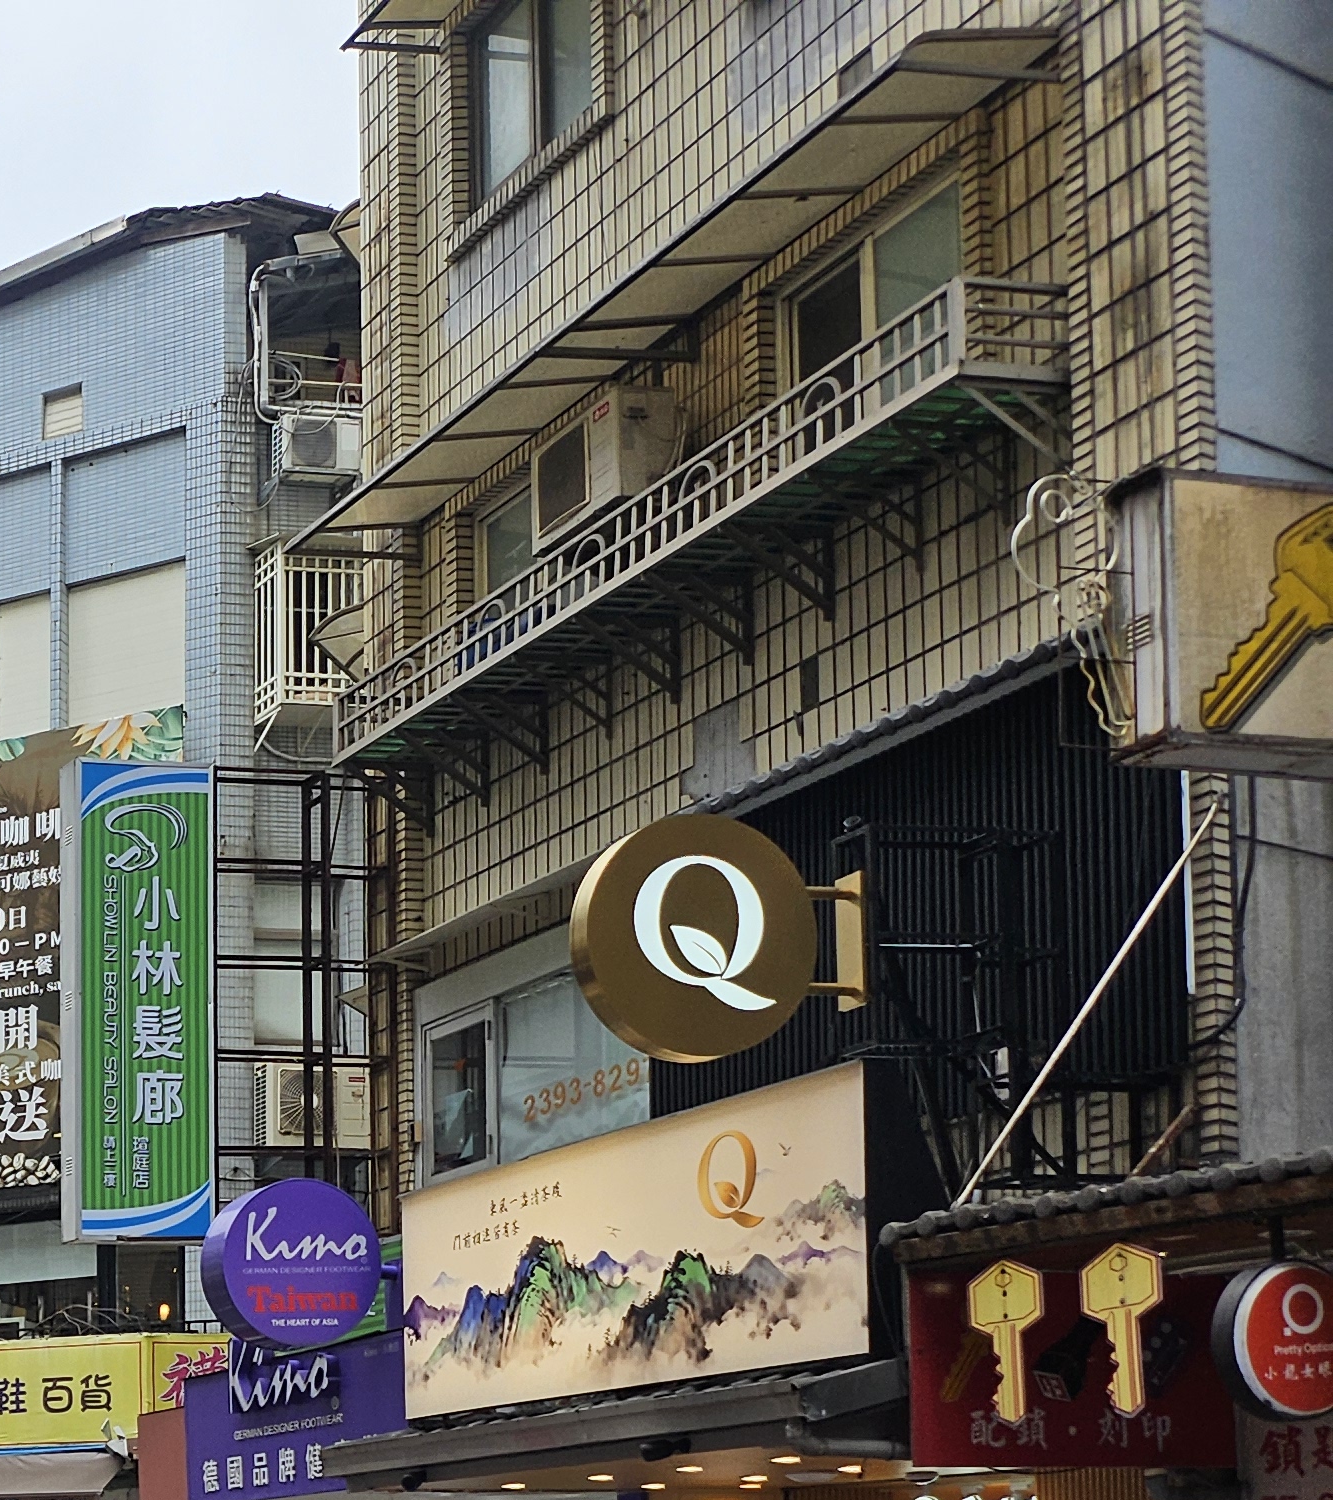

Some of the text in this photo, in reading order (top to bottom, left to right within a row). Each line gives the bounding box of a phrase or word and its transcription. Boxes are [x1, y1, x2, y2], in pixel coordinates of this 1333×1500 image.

[103, 971, 118, 1049] BEAUTY
[132, 875, 184, 1126] 小林髮廊
[103, 1056, 118, 1125] SALON
[522, 1056, 645, 1122] 2393-829
[697, 1130, 765, 1229] Q
[245, 1206, 368, 1262] Kimo
[242, 1265, 371, 1275] GERMAN DESIGNER FOOTWEAR
[246, 1285, 358, 1313] Taiwan
[271, 1319, 285, 1327] THE
[286, 1318, 310, 1327] HEART
[322, 1318, 339, 1326] ASIA
[41, 1373, 113, 1414] 百貨
[229, 1341, 328, 1414] Kimo
